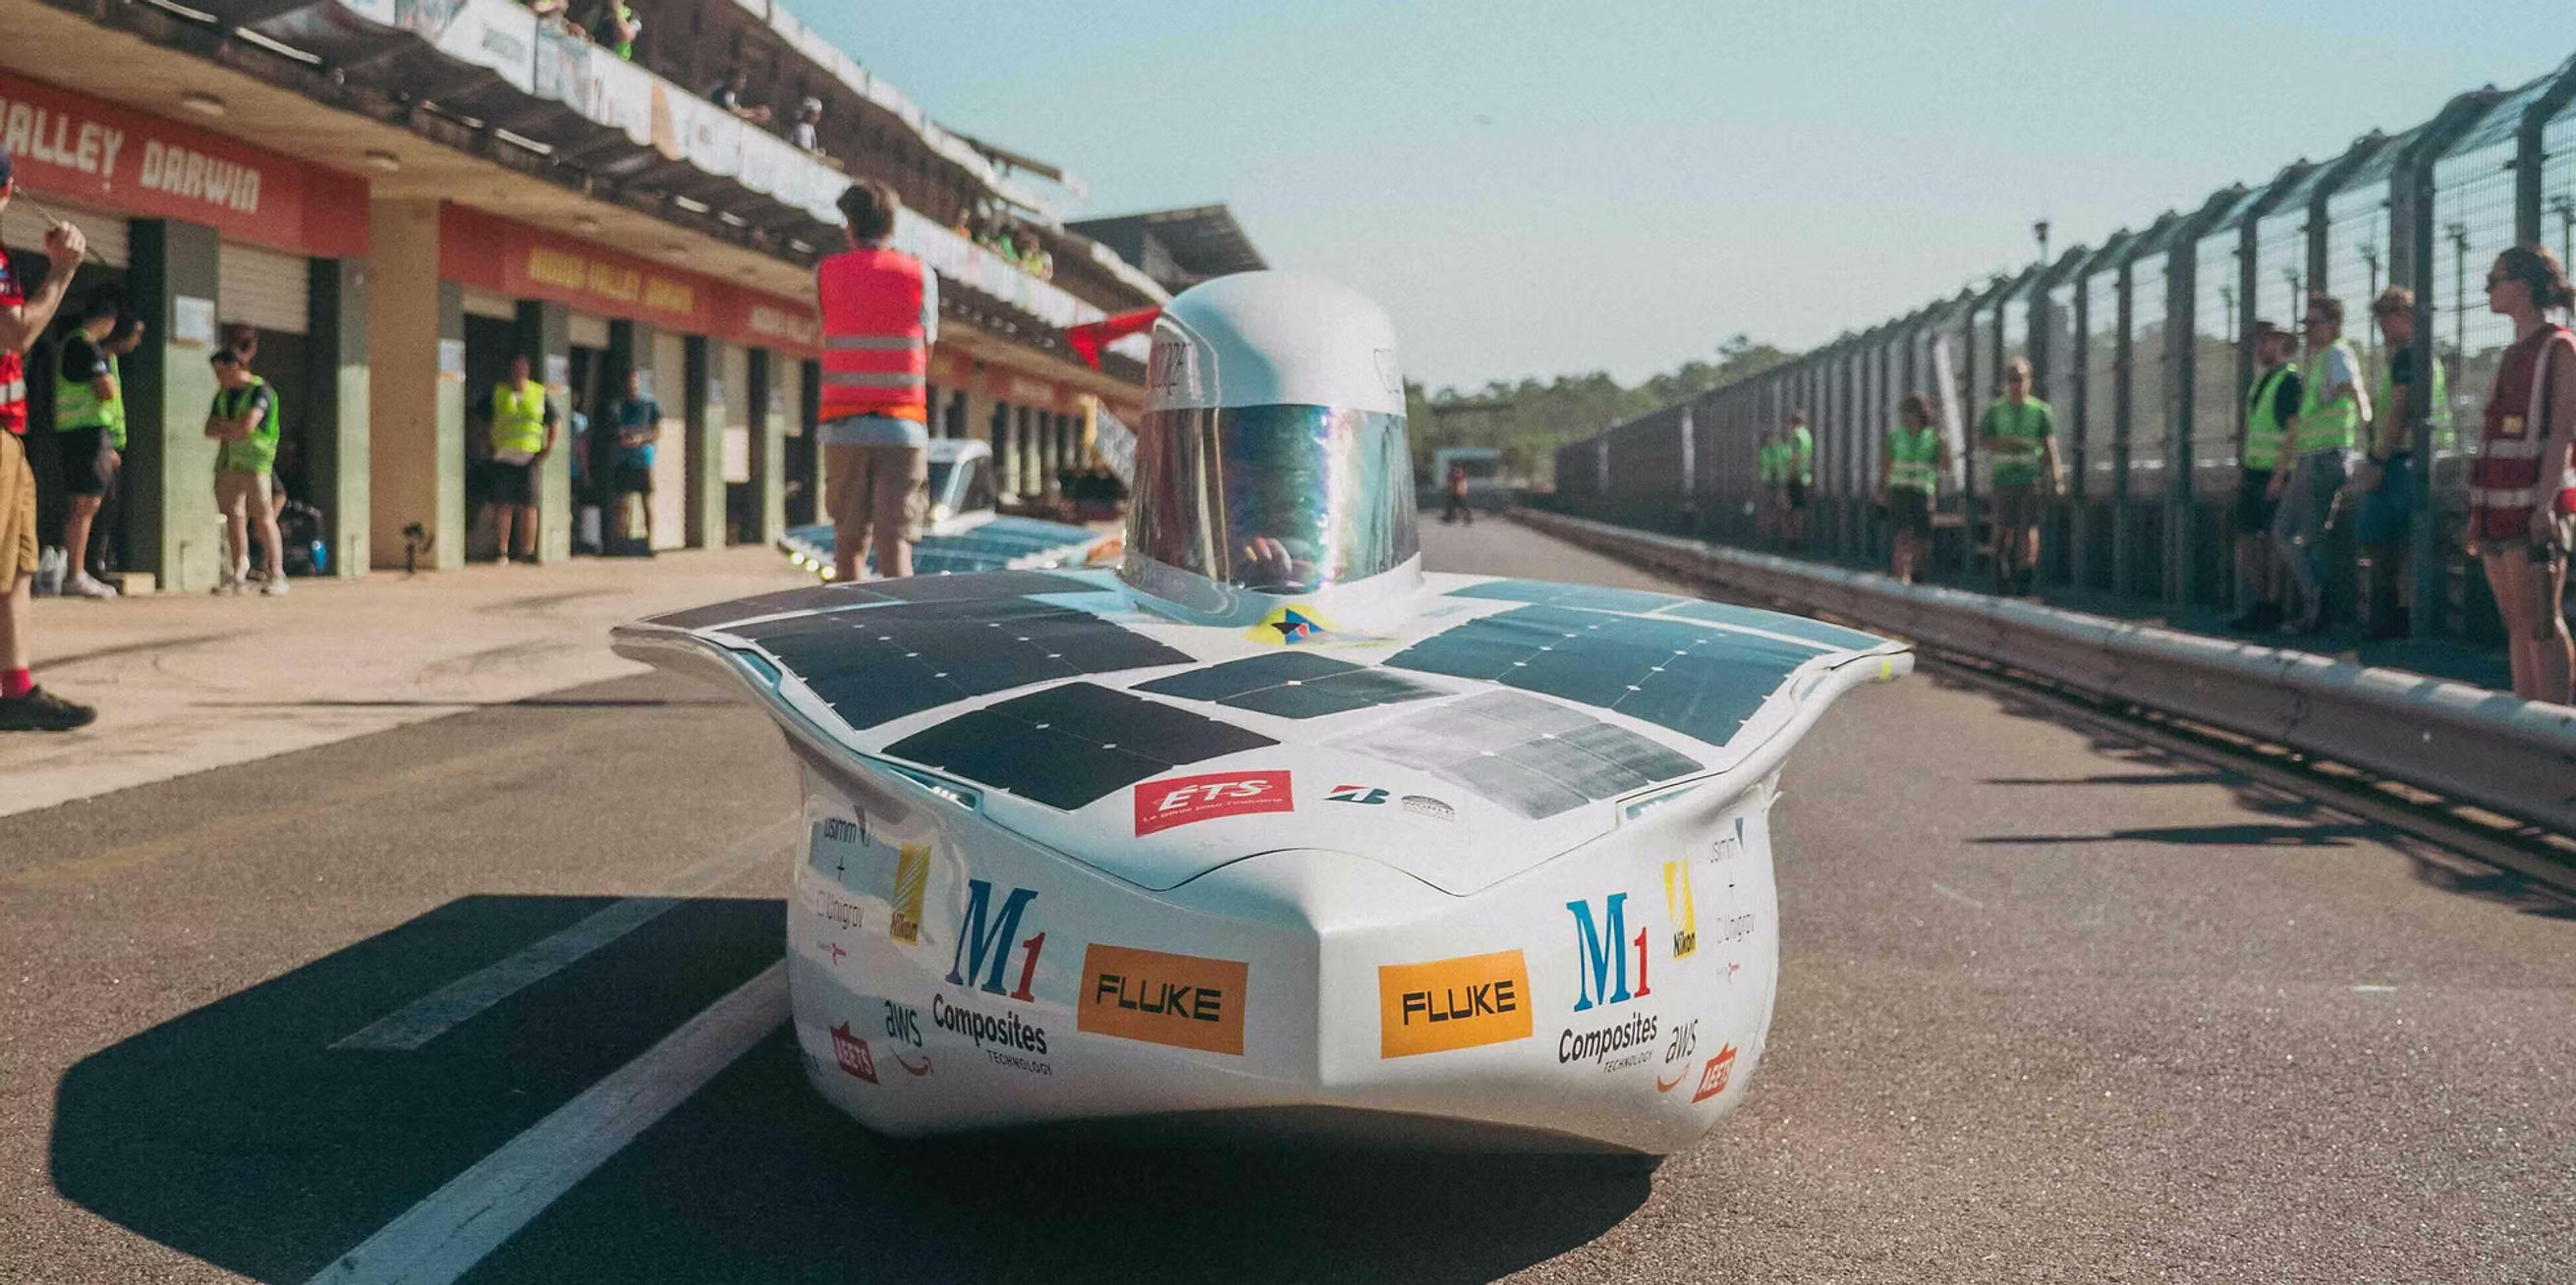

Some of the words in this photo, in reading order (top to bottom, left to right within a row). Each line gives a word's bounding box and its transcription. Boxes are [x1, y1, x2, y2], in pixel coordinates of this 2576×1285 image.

[140, 139, 260, 213] DARWIN
[1674, 931, 1696, 958] Nikon
[1095, 974, 1222, 1023] FLUKE
[1402, 980, 1516, 1026] FLUKE
[885, 1000, 923, 1048] aws
[933, 993, 1047, 1055] Composites
[1559, 1012, 1657, 1064] Composites
[1665, 1019, 1698, 1064] aws
[986, 1049, 1053, 1076] TECHNOLOGY
[1603, 1050, 1653, 1074] TECHNOLOGY
